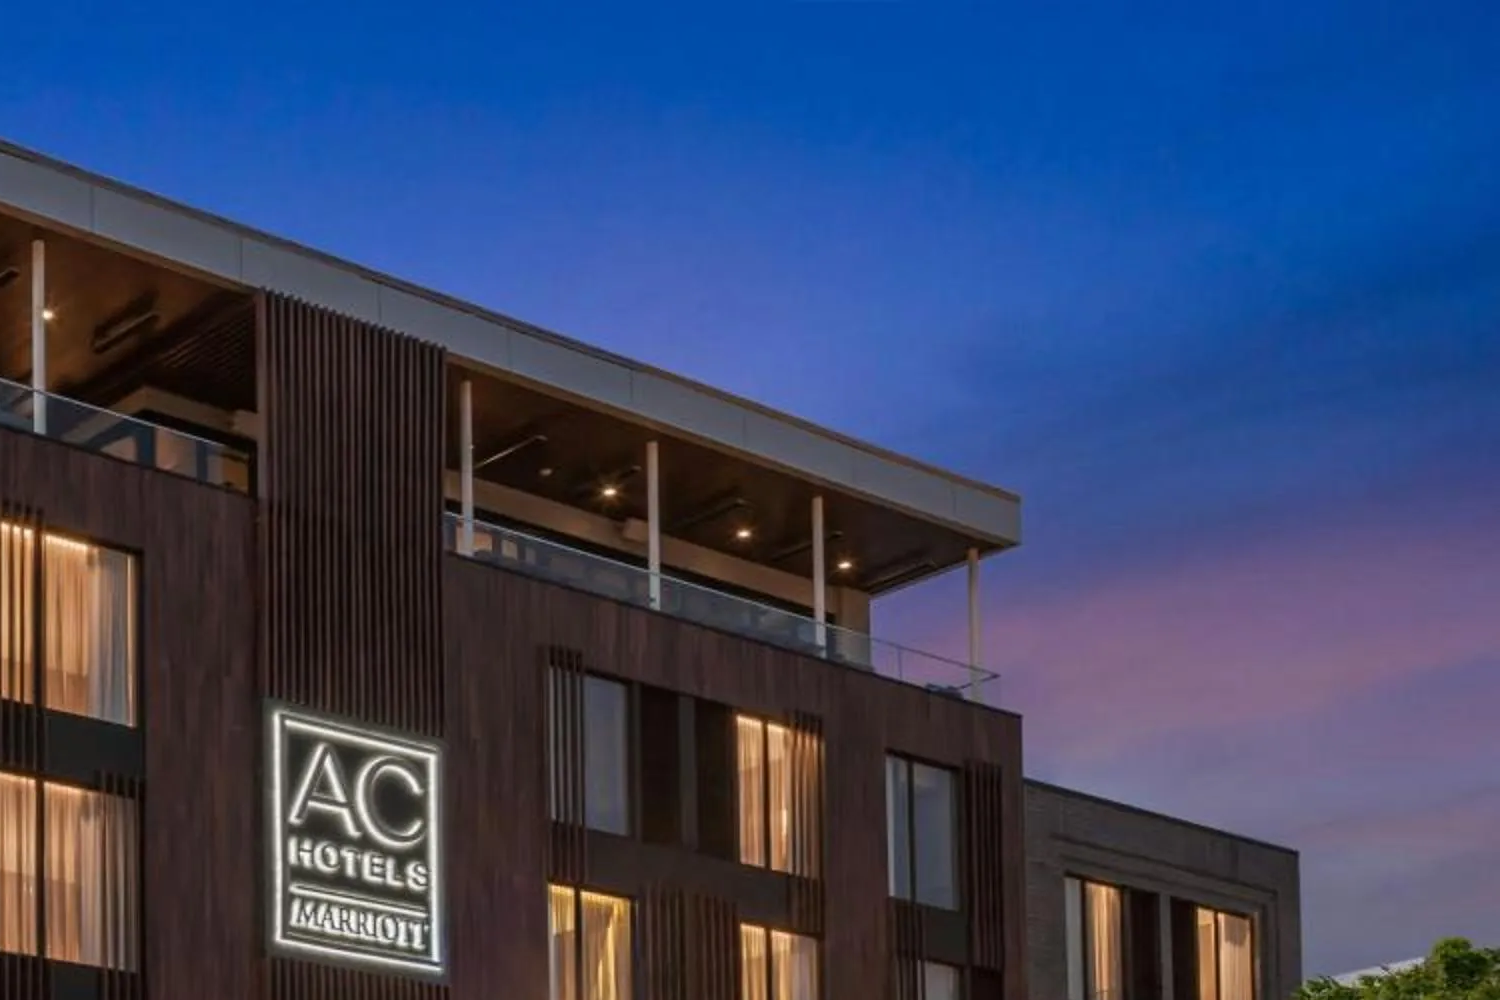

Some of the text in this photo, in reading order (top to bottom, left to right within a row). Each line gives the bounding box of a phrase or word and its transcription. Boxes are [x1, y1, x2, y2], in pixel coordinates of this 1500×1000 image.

[288, 742, 427, 849] AC
[287, 836, 429, 892] HOTELS
[289, 897, 429, 950] MARRIOTT
